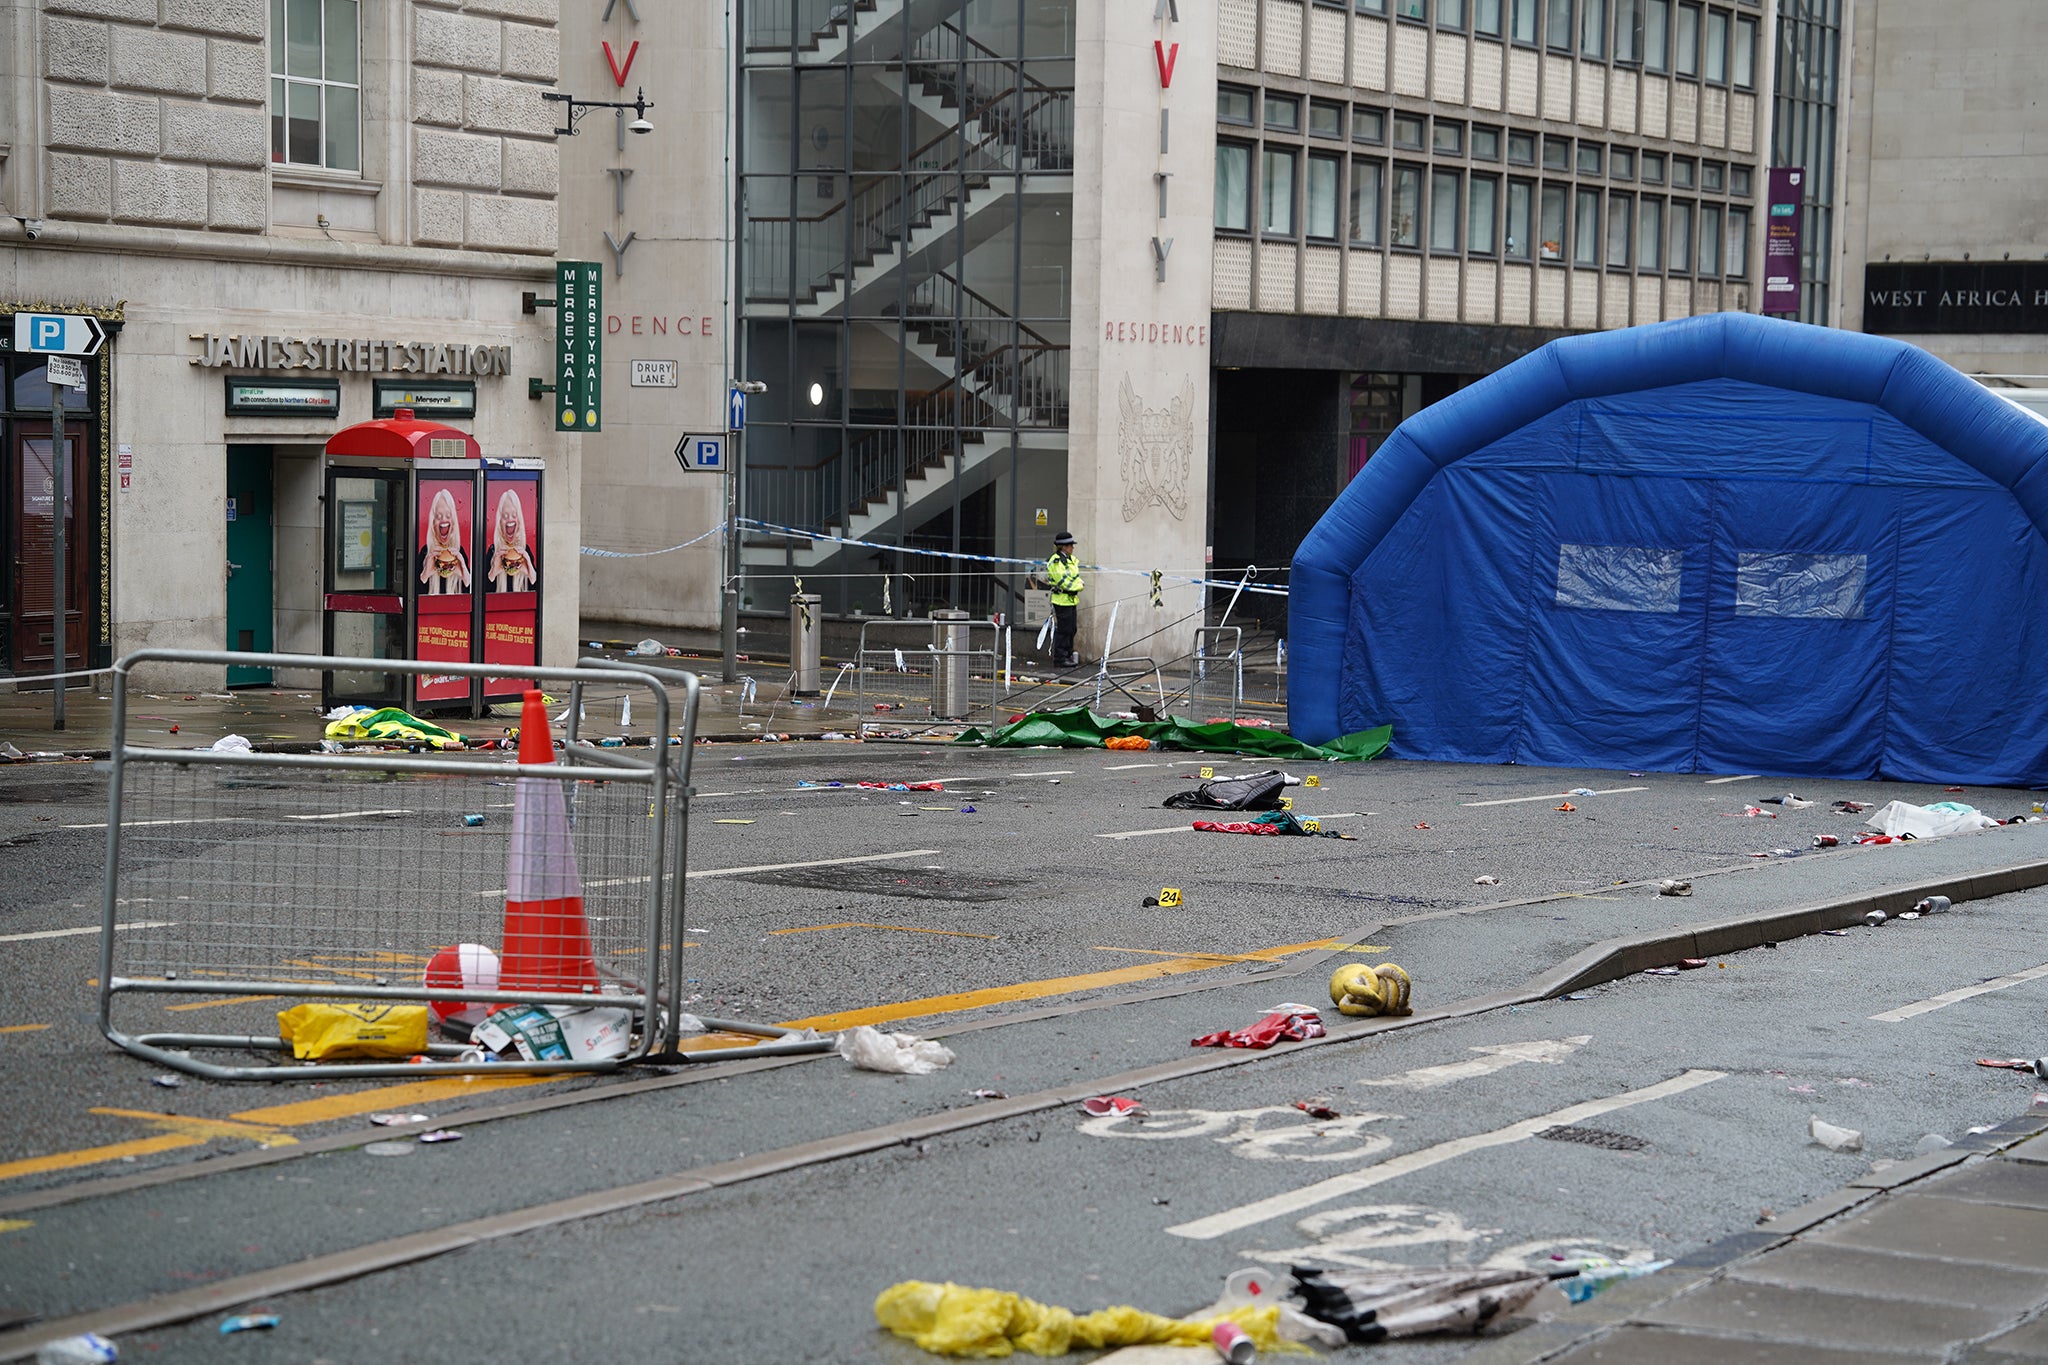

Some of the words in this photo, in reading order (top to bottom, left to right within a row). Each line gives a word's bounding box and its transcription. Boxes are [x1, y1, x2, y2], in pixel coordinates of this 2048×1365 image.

[1870, 290, 1927, 307] WEST
[1938, 290, 2022, 307] AFRICA
[607, 315, 713, 336] DENCE
[39, 320, 60, 347] P
[563, 270, 575, 405] MERSEYRAIL
[587, 271, 596, 406] MERSEYRAIL
[1105, 322, 1207, 345] RESIDENCE
[197, 333, 295, 370] JAMES
[302, 336, 397, 372] STREET
[402, 341, 511, 377] STATION
[637, 363, 672, 373] DRURY
[640, 374, 666, 384] LANE
[308, 397, 318, 405] City
[415, 395, 451, 404] Merseyrail
[702, 443, 716, 464] P
[429, 627, 458, 638] YOURSELF
[459, 631, 468, 639] IN
[495, 623, 524, 634] YOURSELF
[524, 627, 533, 635] IN
[447, 639, 468, 648] TASTE
[514, 635, 533, 644] TASTE
[1201, 769, 1212, 777] 27
[1306, 777, 1316, 785] 26
[1304, 823, 1317, 832] 23
[1160, 891, 1178, 903] 24
